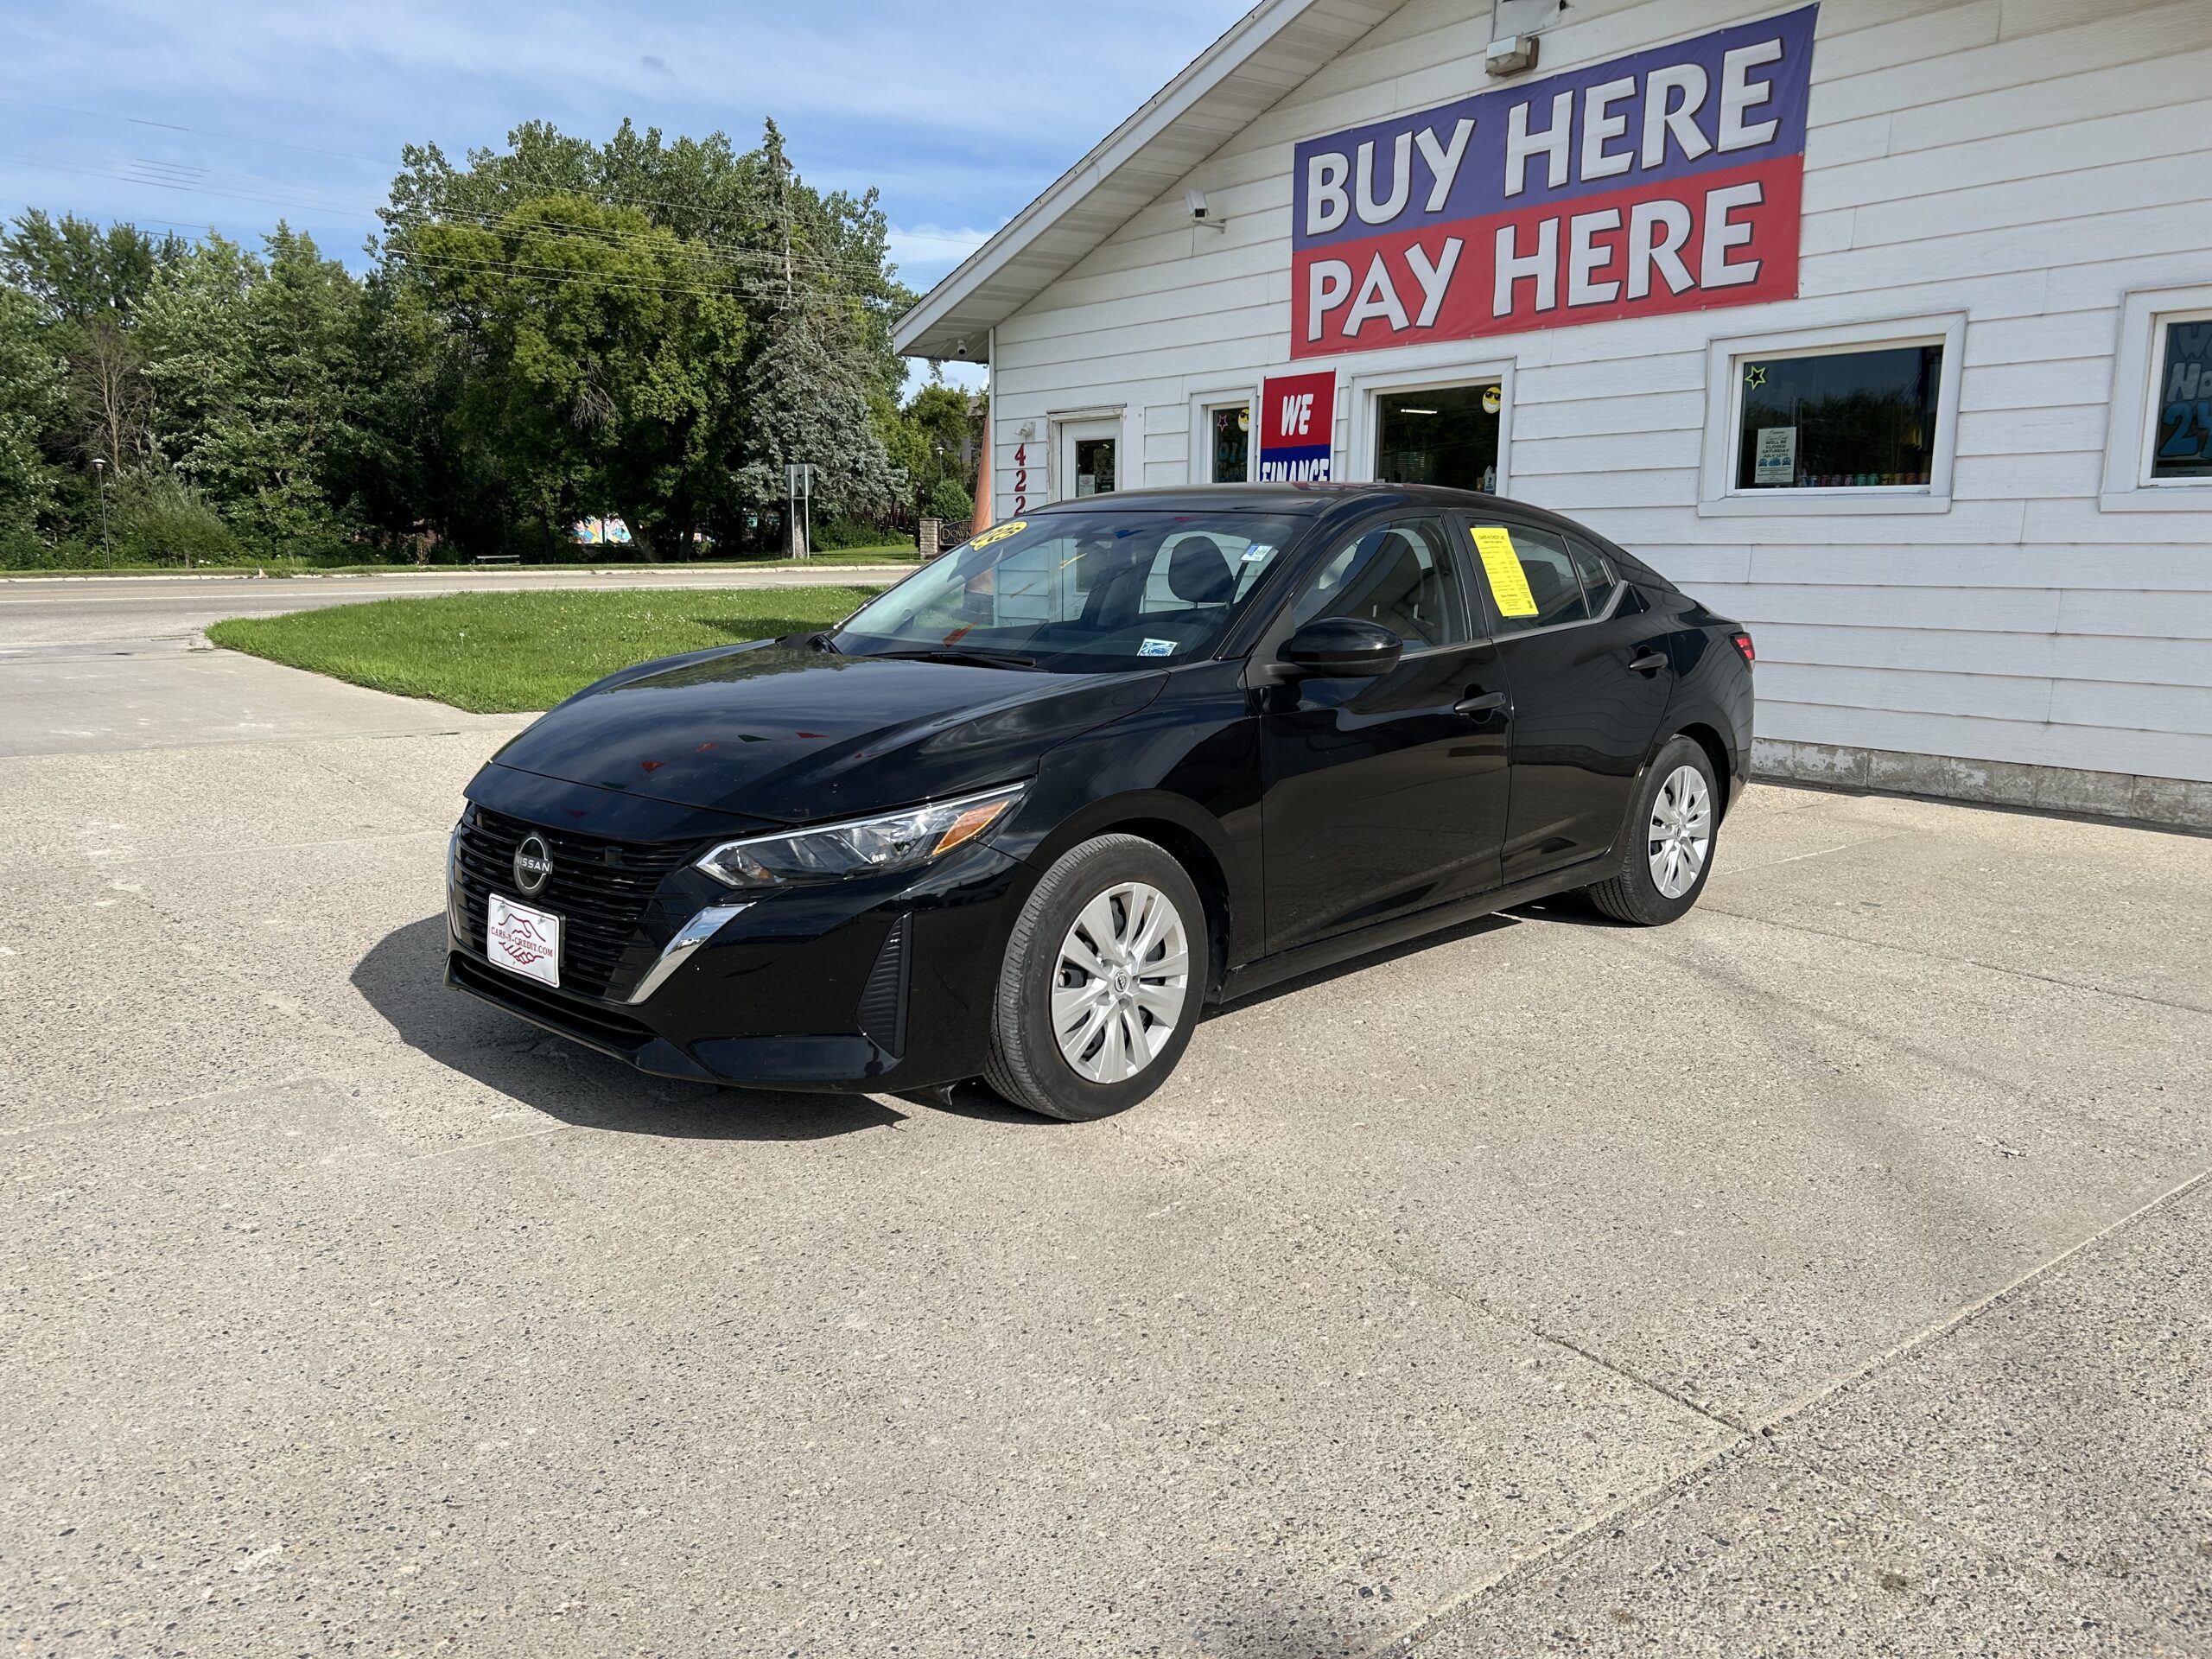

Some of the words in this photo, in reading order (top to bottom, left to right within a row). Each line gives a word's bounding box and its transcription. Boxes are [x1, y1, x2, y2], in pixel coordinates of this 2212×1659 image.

[1306, 118, 1476, 238] BUY
[1504, 37, 1784, 200] HERE
[1306, 236, 1466, 343] PAY
[1492, 181, 1766, 320] HERE
[1281, 393, 1314, 436] WE
[491, 926, 553, 957] CARS-N-CREDIT.COM
